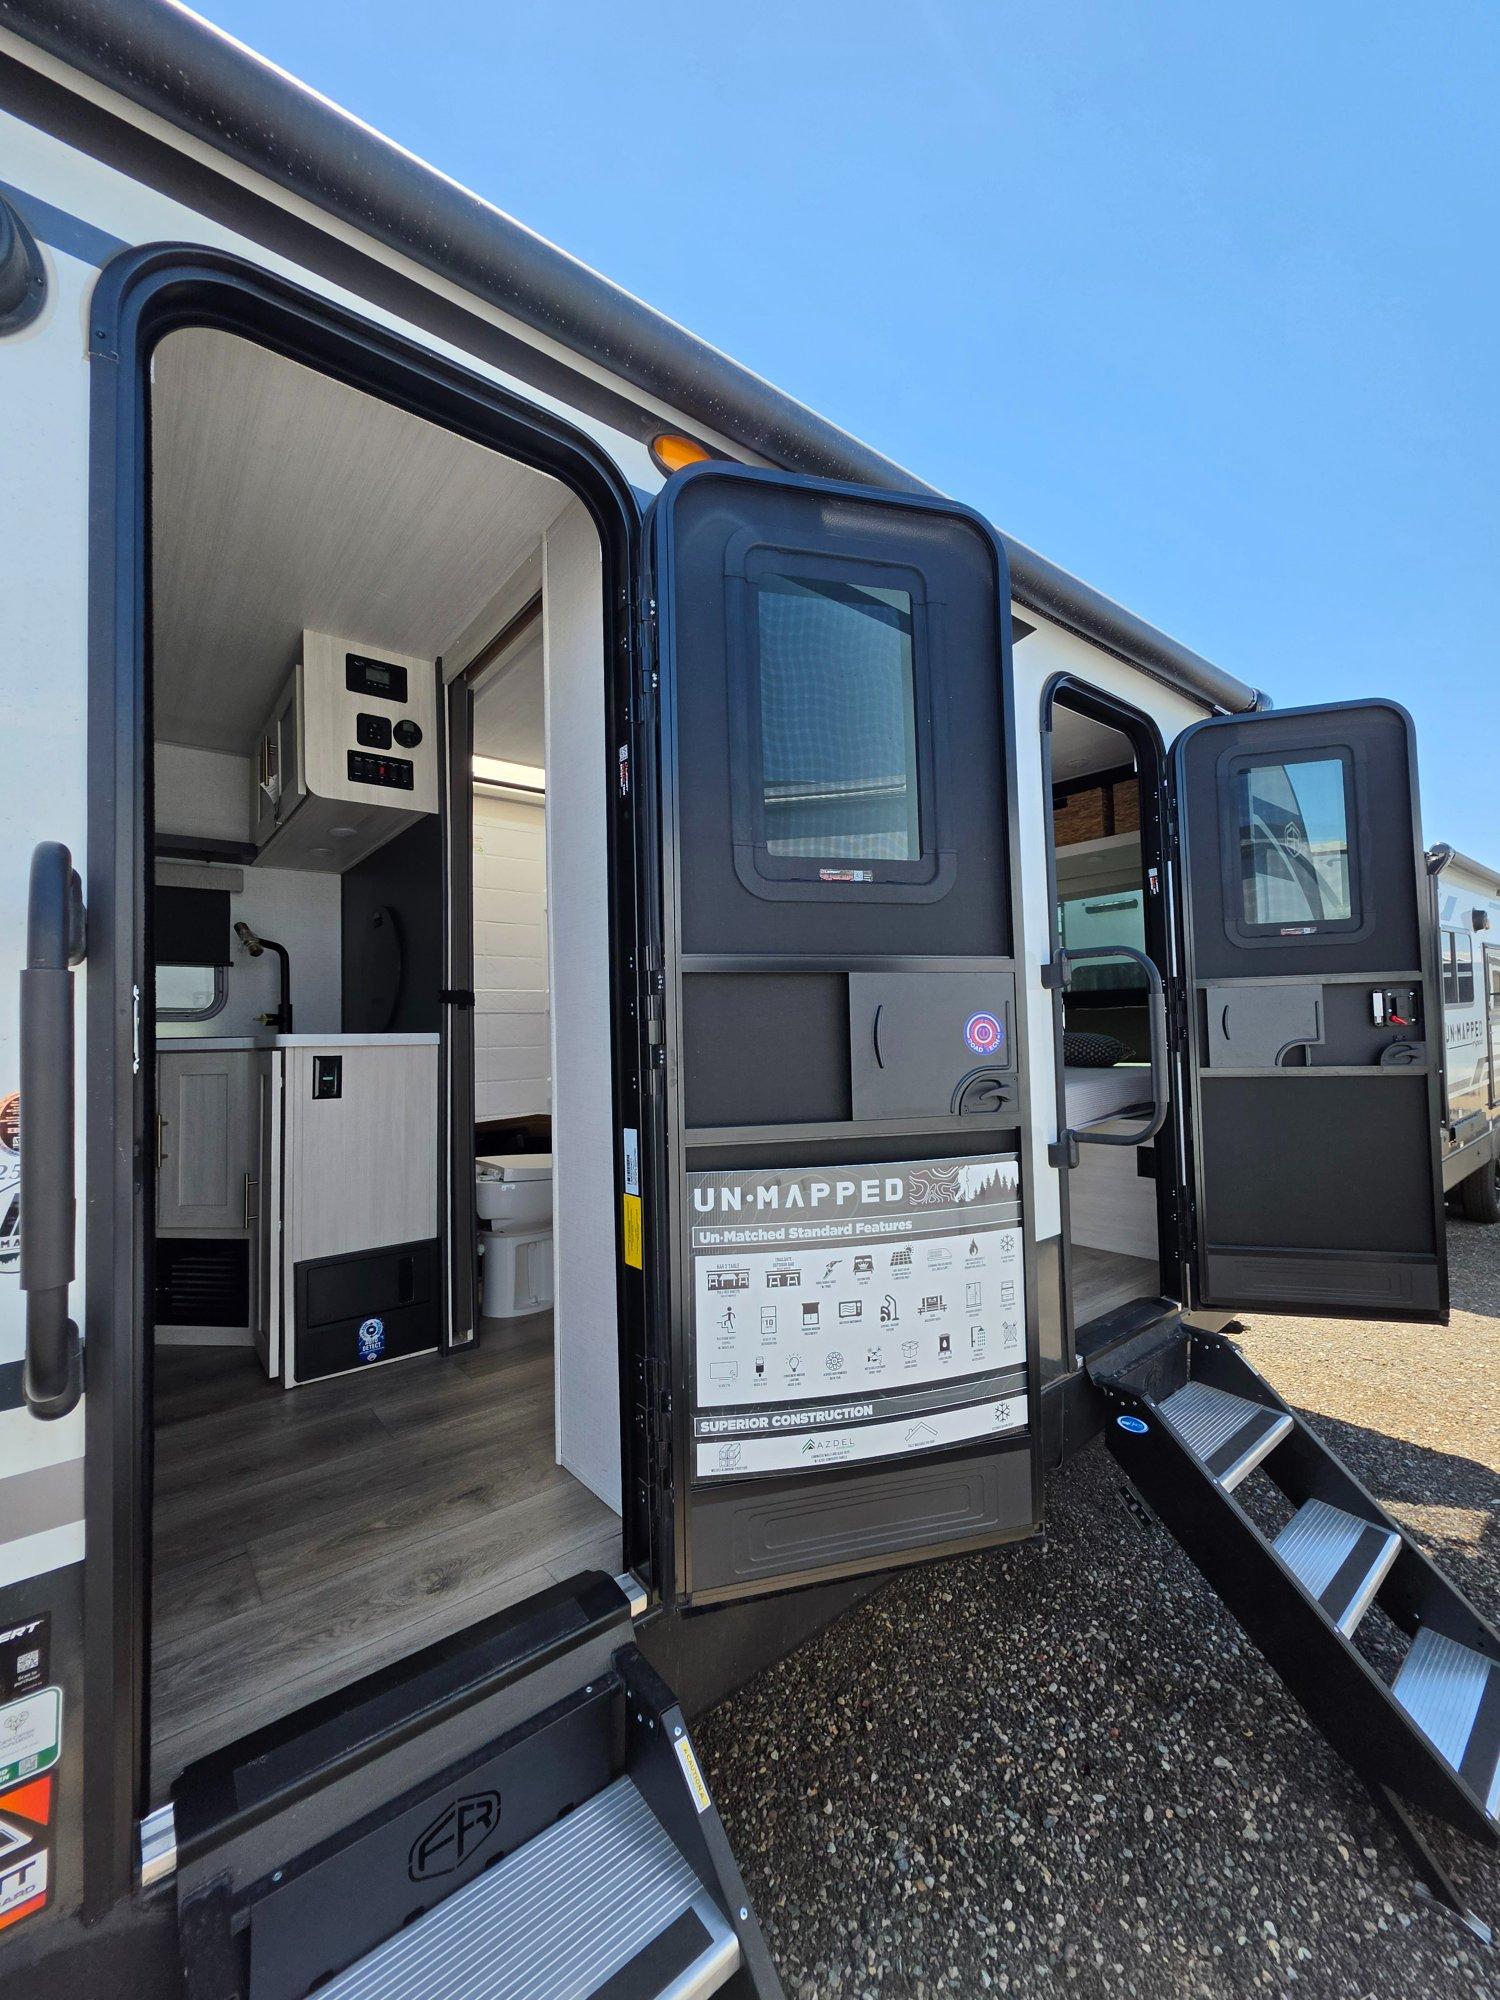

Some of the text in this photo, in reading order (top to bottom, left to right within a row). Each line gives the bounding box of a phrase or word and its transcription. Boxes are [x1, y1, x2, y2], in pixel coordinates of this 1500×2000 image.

[788, 1223, 853, 1240] Standard
[855, 1219, 913, 1235] Features
[765, 1319, 773, 1327] 10
[362, 1342, 382, 1352] DETECT
[700, 1405, 873, 1433] SUPERIOR CONSTRUCTION
[816, 1438, 855, 1449] AZDEL
[686, 1754, 703, 1792] CAUTION
[0, 1884, 36, 1907] ARD
